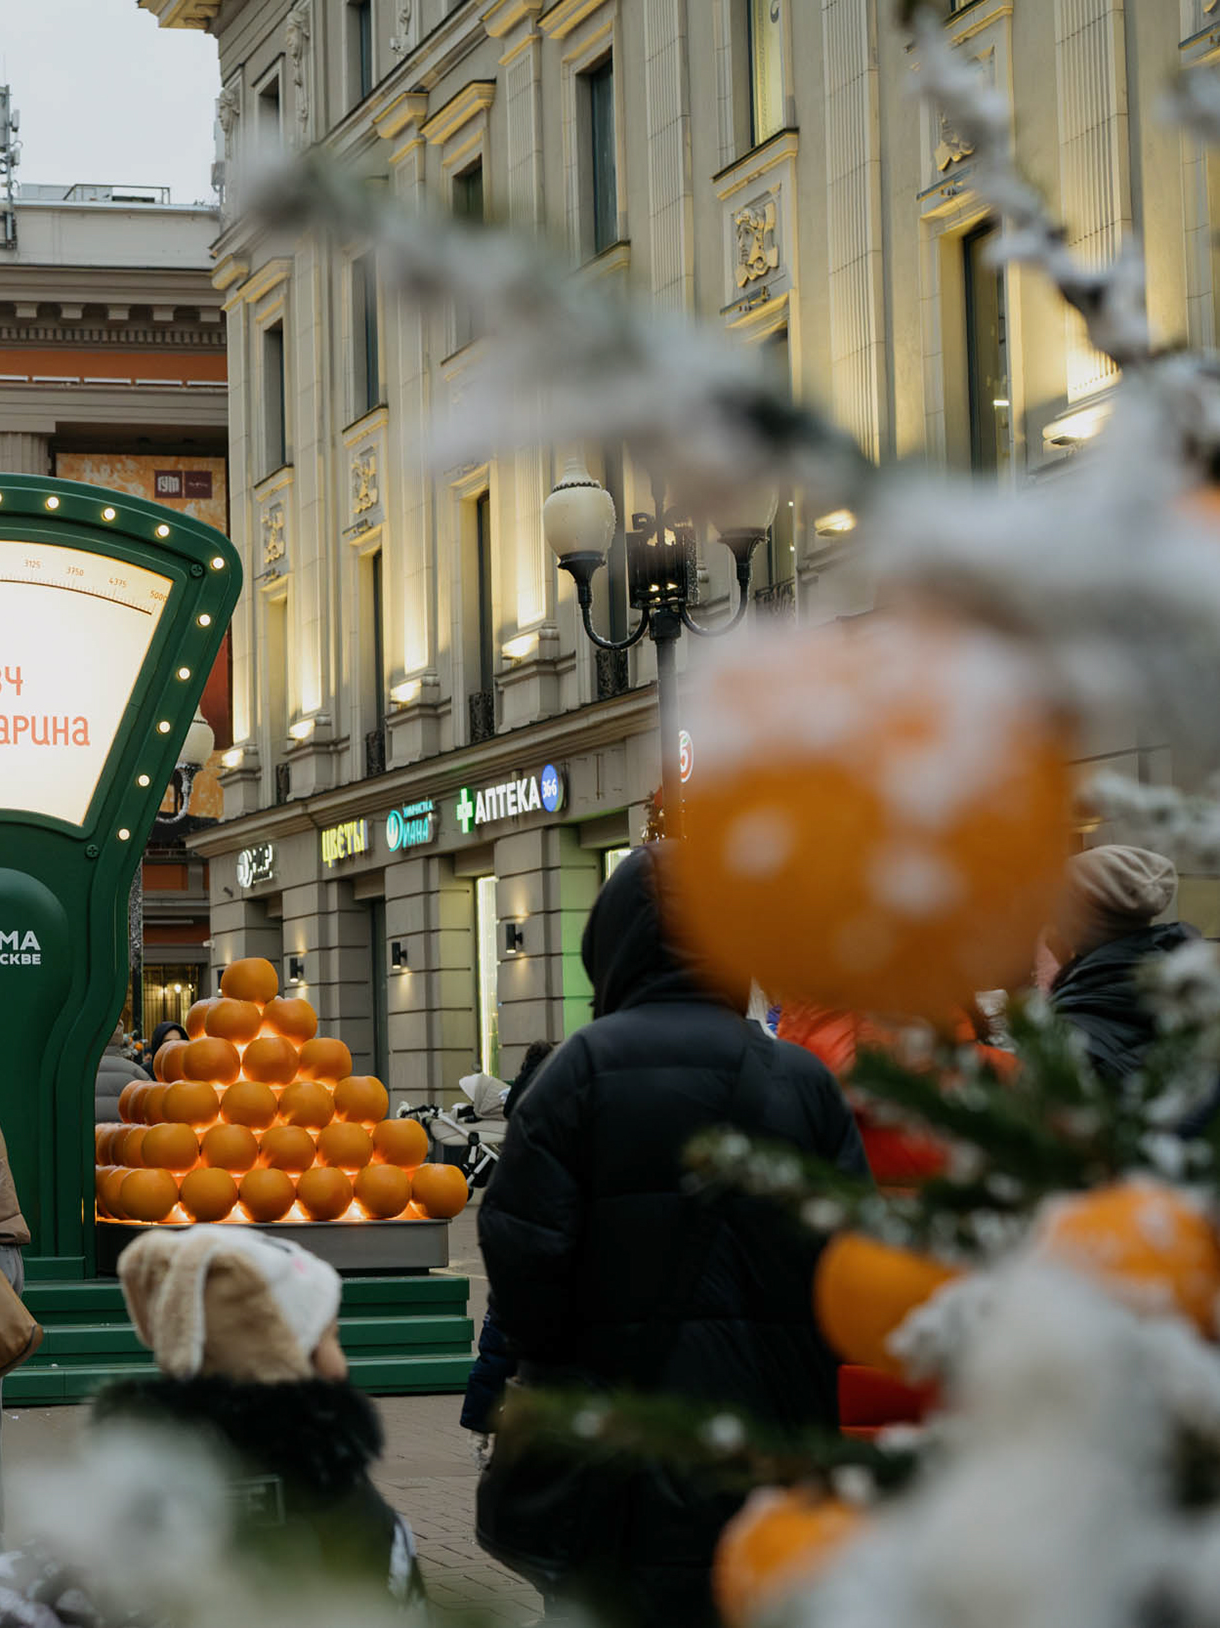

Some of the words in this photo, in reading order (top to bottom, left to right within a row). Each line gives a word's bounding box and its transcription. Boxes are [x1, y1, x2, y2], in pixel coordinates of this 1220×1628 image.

[24, 559, 41, 569] 3125
[66, 566, 84, 577] 3750
[108, 577, 127, 588] 4375
[475, 775, 541, 825] АПТЕКА
[321, 819, 366, 868] ЦВЕТЫ
